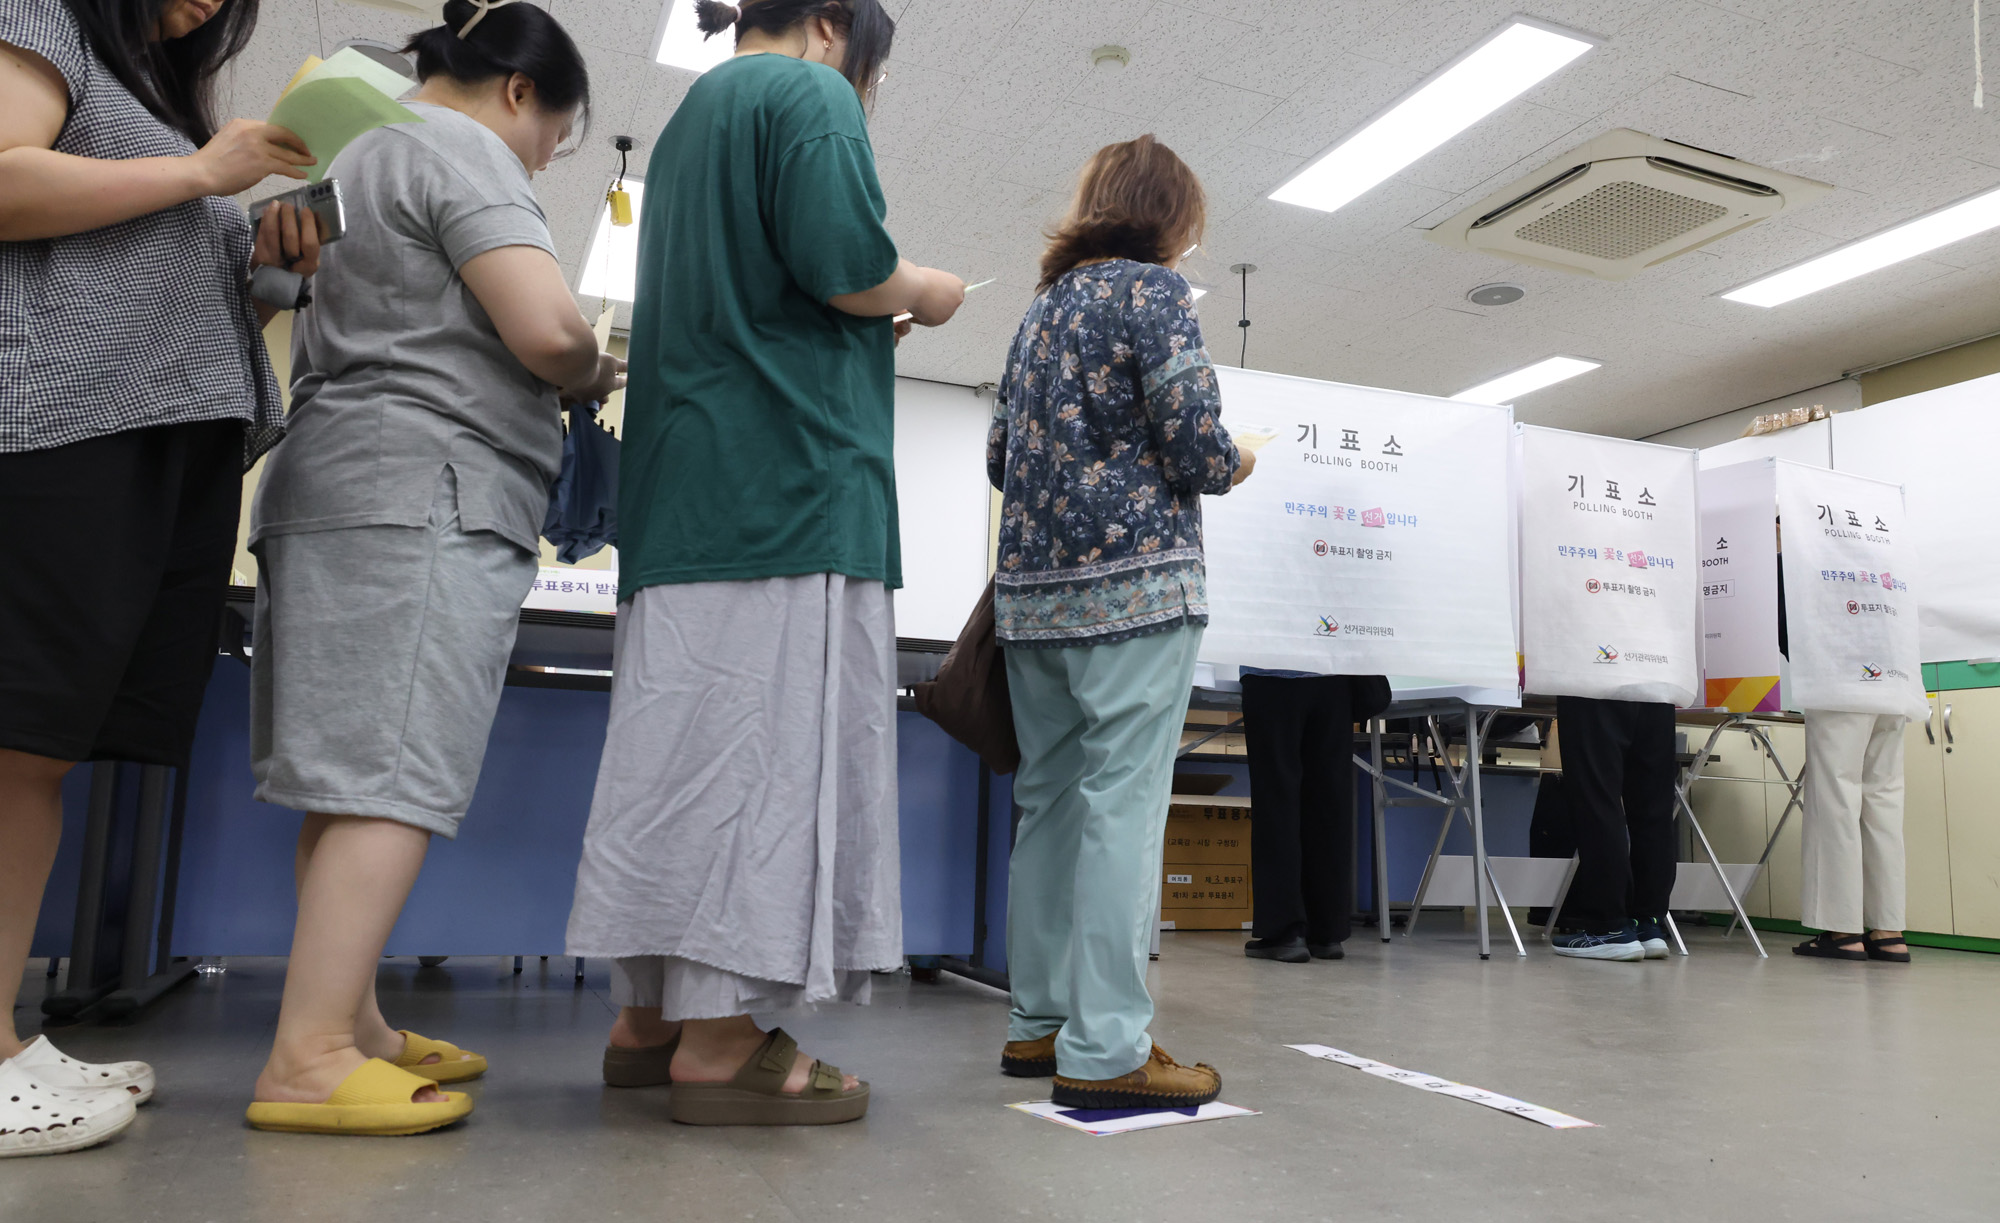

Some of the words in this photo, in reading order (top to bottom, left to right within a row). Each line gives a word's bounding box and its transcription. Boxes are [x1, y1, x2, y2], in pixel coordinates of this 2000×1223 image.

[1303, 453, 1352, 468] POLLING
[1360, 459, 1398, 473] BOOTH
[1285, 501, 1328, 518] 민주주의
[1333, 505, 1357, 521] 꽃은
[1573, 501, 1617, 514] POLLING
[1622, 508, 1653, 521] BOOTH
[1824, 528, 1862, 540] POLLING
[1866, 533, 1891, 545] BOOTH
[1329, 545, 1354, 558] 투표지
[1356, 547, 1374, 559] 촬영
[1376, 549, 1392, 561] 금지
[1558, 545, 1597, 560] 민주주의
[1603, 547, 1624, 561] 꽃은
[1821, 570, 1856, 582] 민주주의
[1859, 570, 1878, 584] 꽃은
[532, 580, 589, 594] 투표용지
[1603, 583, 1626, 593] 투표지
[1627, 585, 1642, 595] 촬영
[1643, 587, 1656, 597] 금지
[1861, 603, 1882, 614] 투표지
[1343, 624, 1394, 637] 선거관리위원회
[1623, 653, 1668, 664] 선거관리위원회
